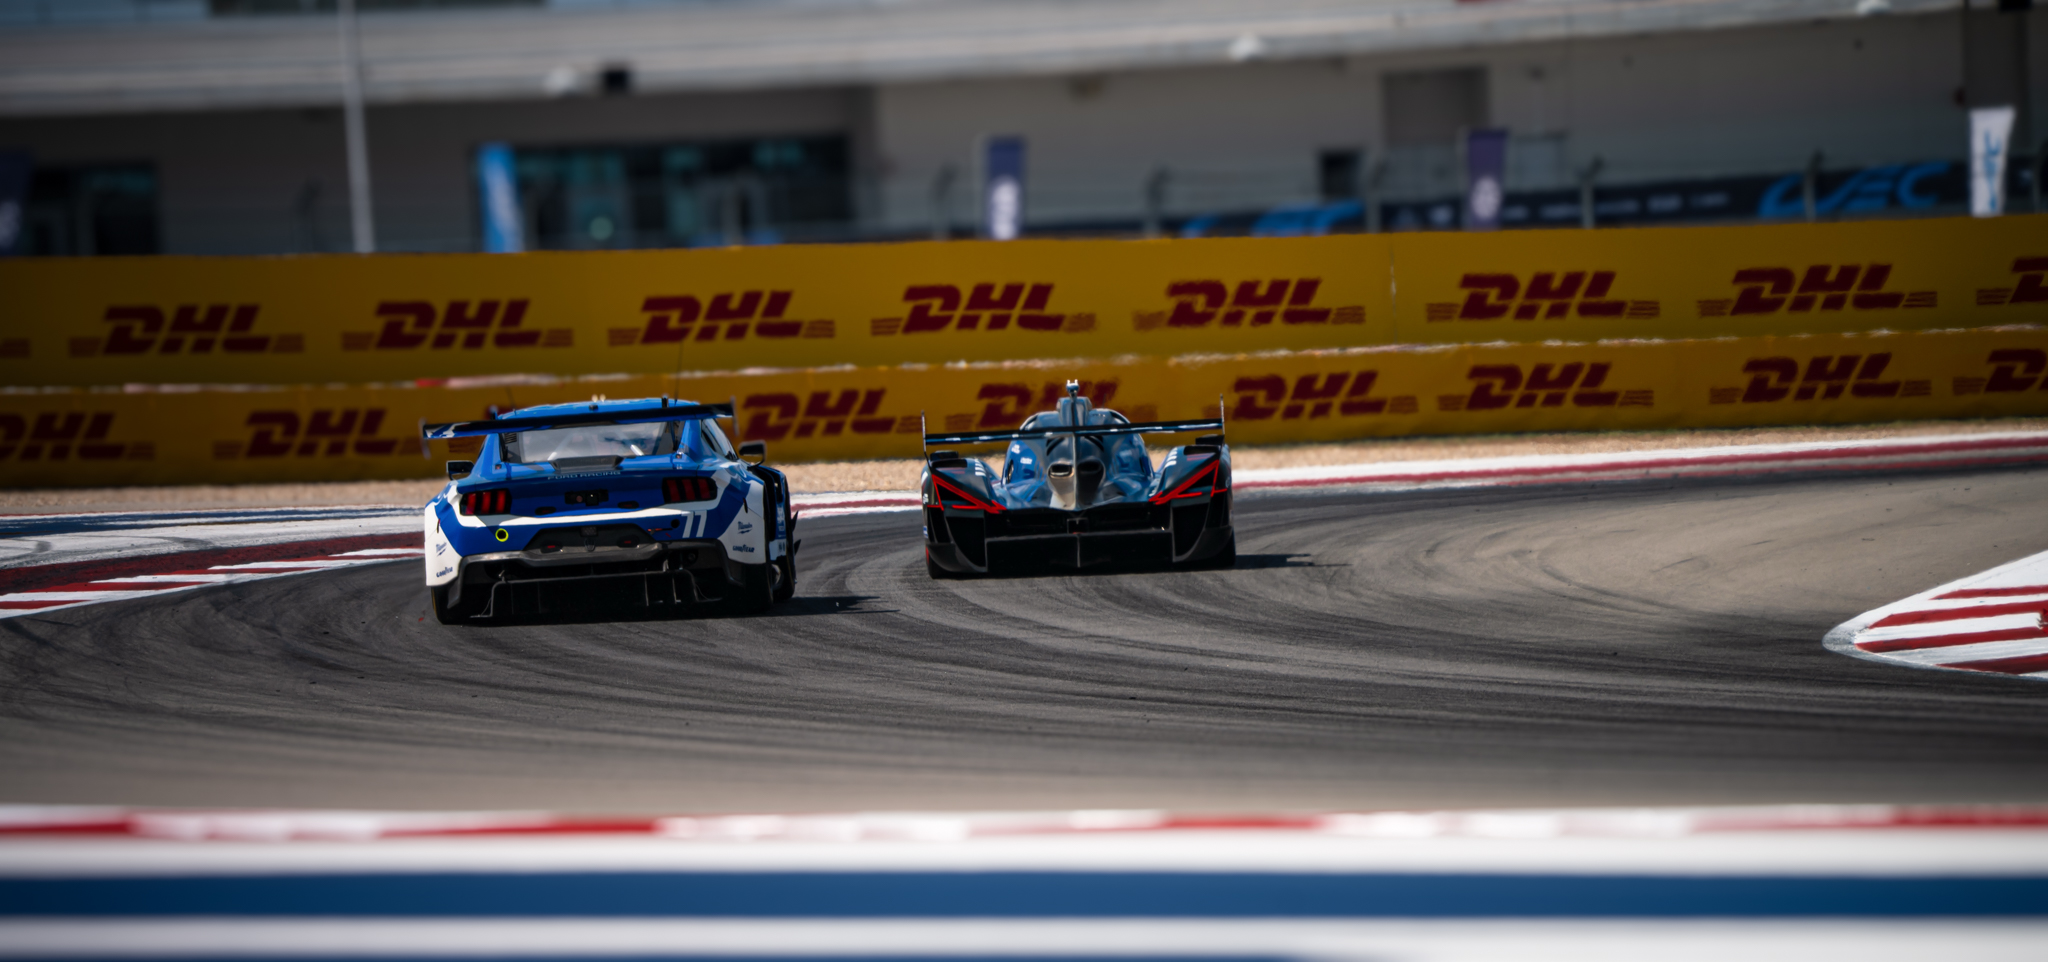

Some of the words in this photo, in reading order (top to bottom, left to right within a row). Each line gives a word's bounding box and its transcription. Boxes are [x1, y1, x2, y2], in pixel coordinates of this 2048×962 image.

[902, 283, 1065, 334] DHL
[1167, 279, 1331, 328] DHL
[1459, 271, 1627, 320] DHL
[1730, 264, 1905, 316] DHL
[103, 305, 270, 355] DHL
[376, 299, 541, 349] DHL
[641, 291, 803, 344] DHL
[1231, 371, 1387, 421] DHL
[1465, 362, 1619, 411] DHL
[1741, 352, 1901, 403] DHL
[245, 409, 398, 458] DHL
[743, 389, 896, 441] DHL
[681, 510, 707, 539] 77
